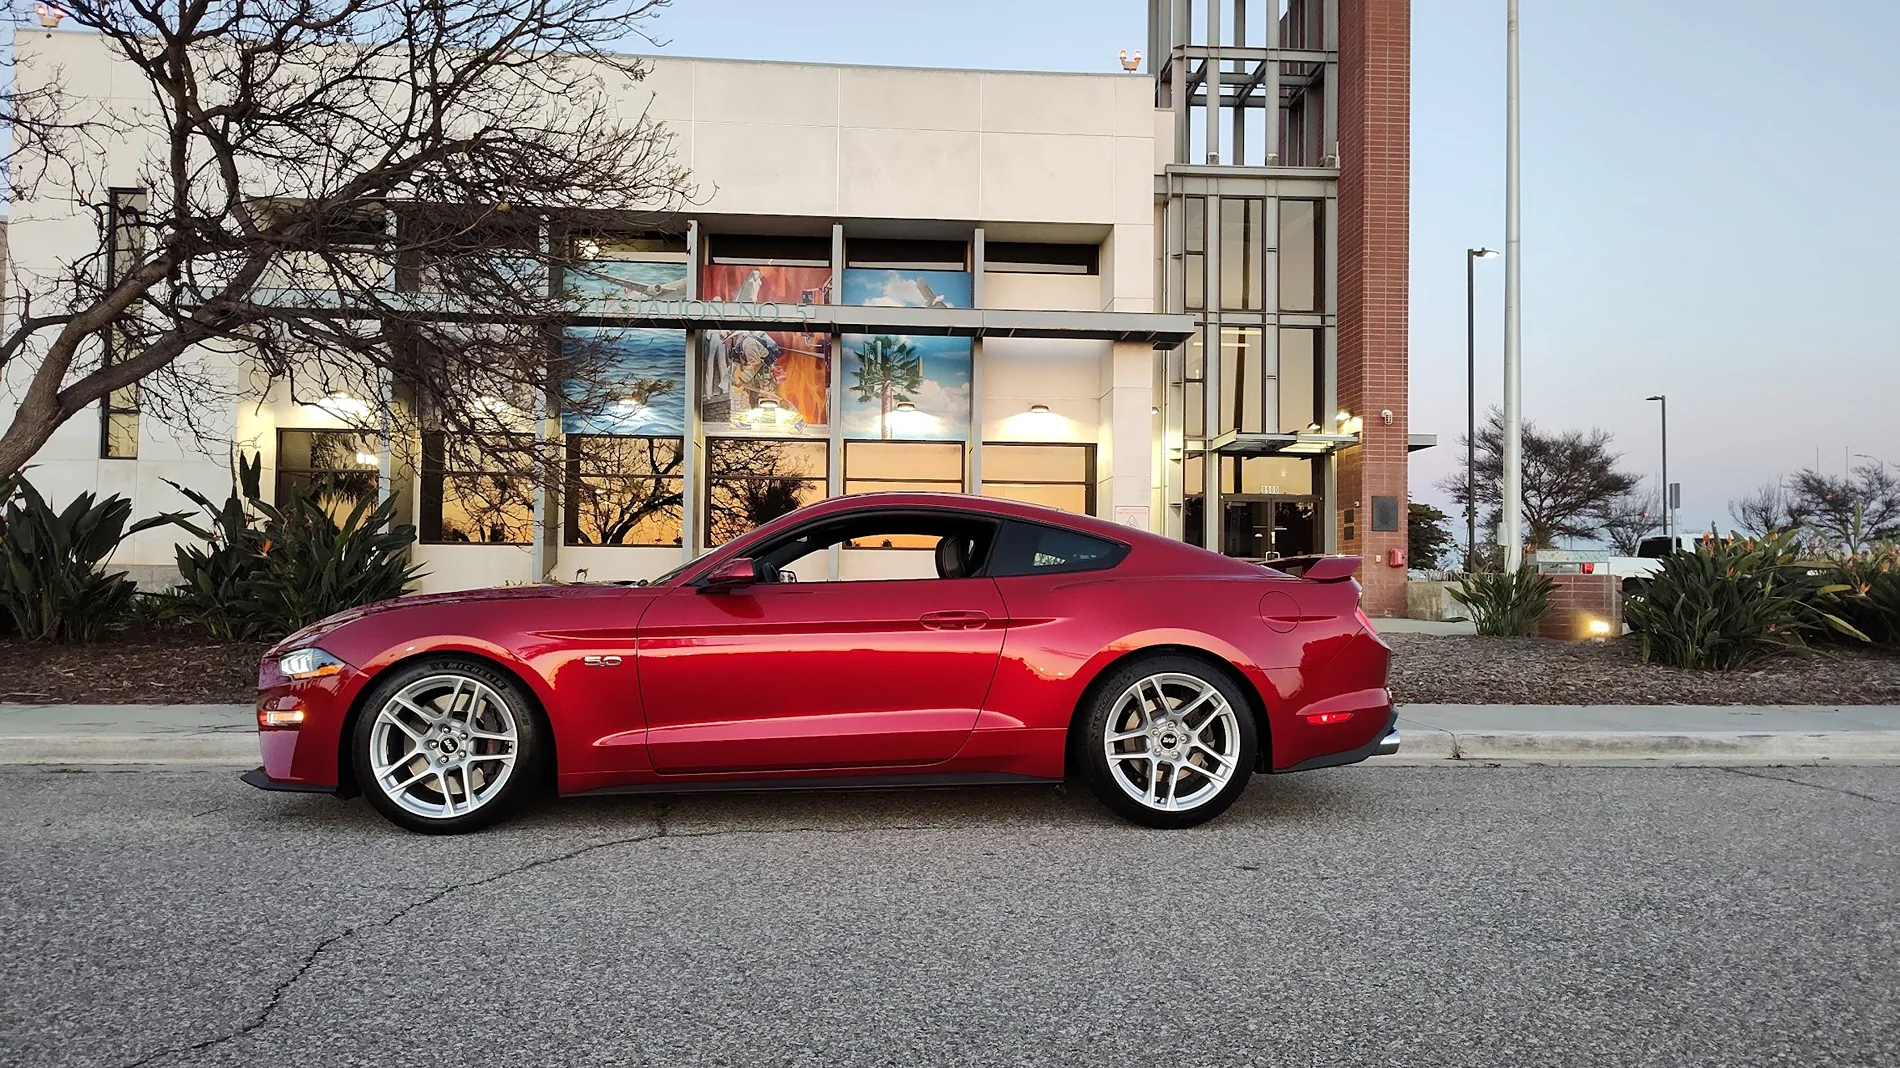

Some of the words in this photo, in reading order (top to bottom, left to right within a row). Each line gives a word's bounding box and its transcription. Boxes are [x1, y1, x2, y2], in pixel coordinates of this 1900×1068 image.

[796, 303, 808, 322] 5
[584, 655, 622, 667] 5.0
[447, 662, 505, 688] MICHELIN
